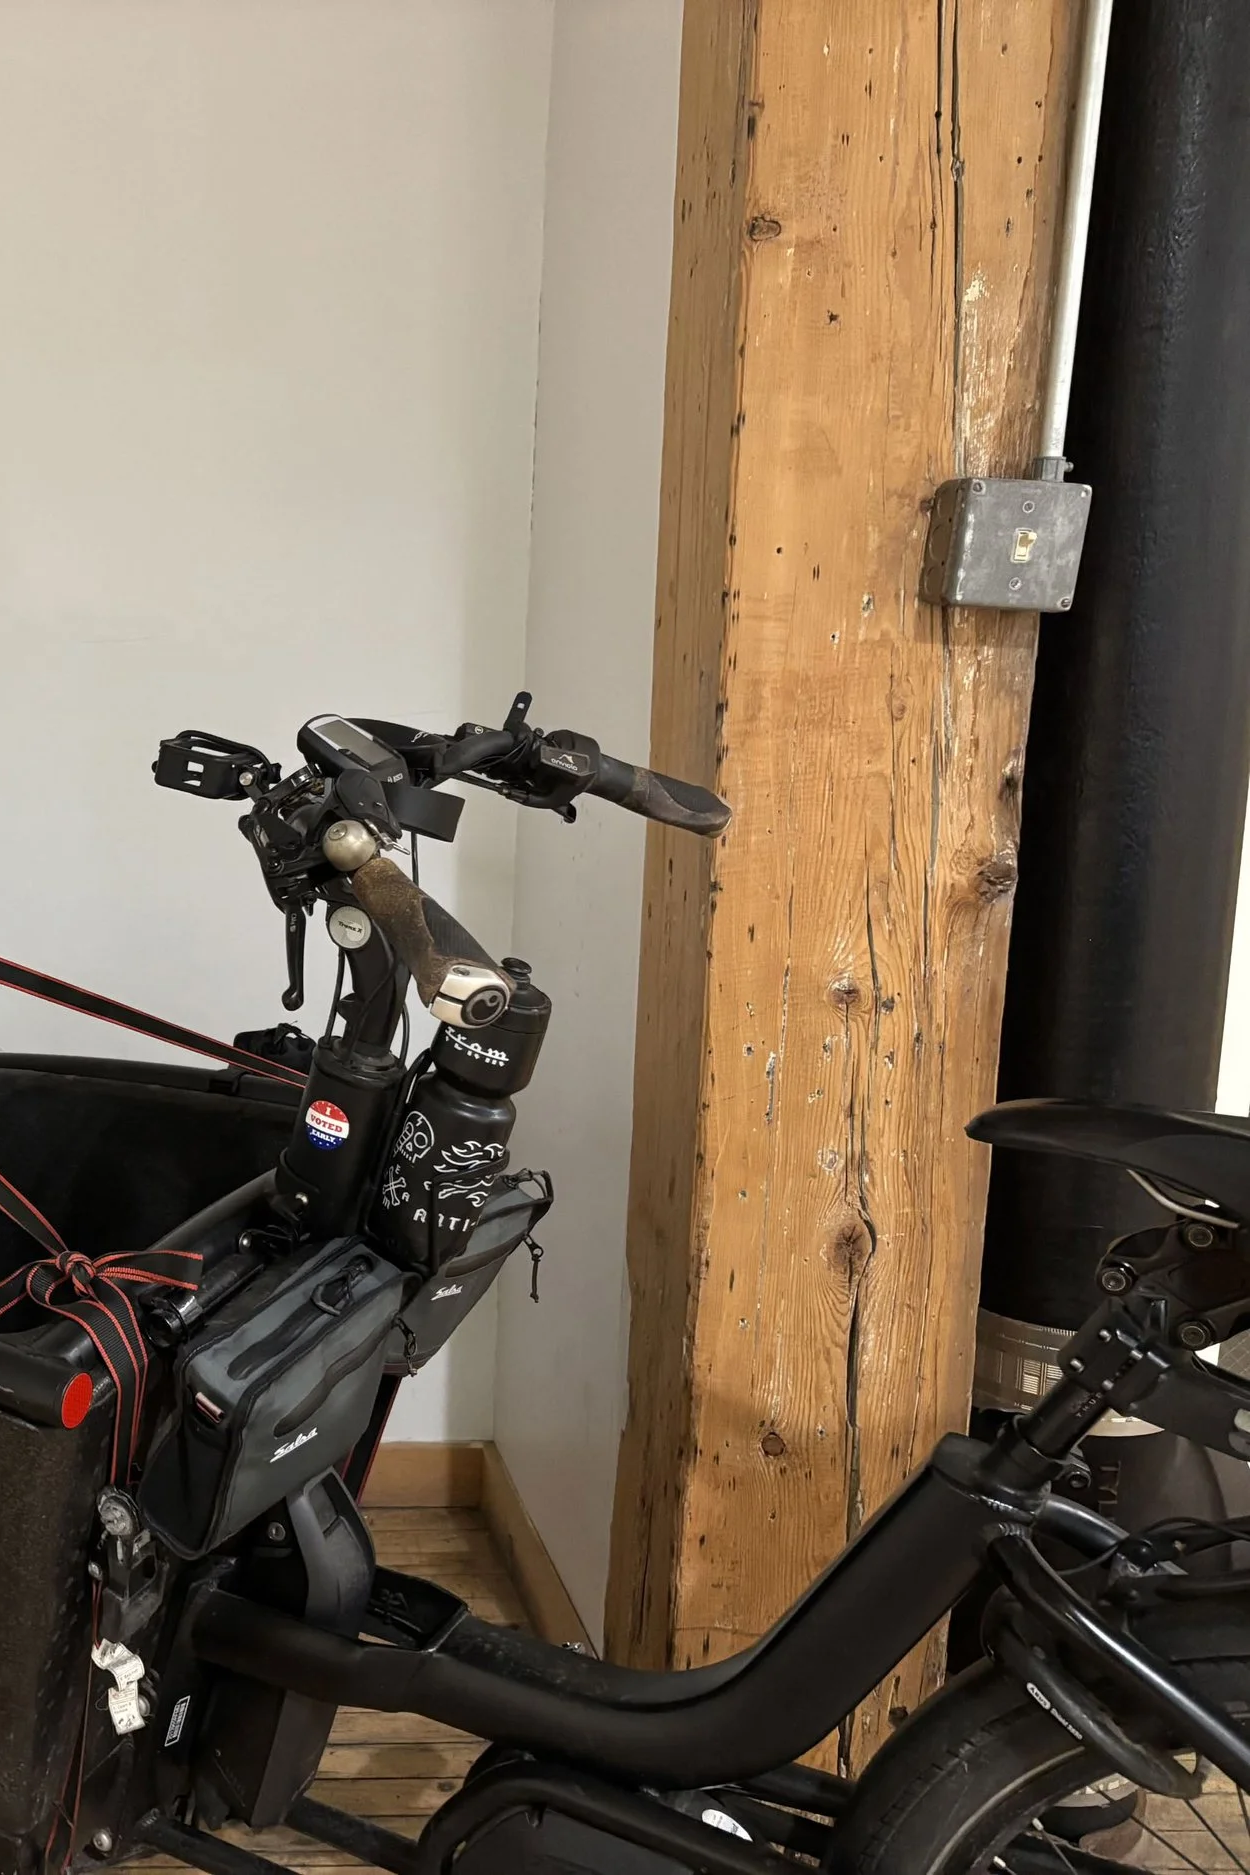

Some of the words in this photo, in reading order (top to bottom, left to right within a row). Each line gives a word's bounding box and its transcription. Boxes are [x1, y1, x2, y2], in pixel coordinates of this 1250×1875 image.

[325, 1106, 332, 1116] I
[310, 1114, 343, 1133] VOTED
[310, 1128, 337, 1143] EARLY
[430, 1284, 464, 1301] Salsa
[269, 1427, 318, 1463] Salsa
[1029, 1685, 1049, 1708] ABUS
